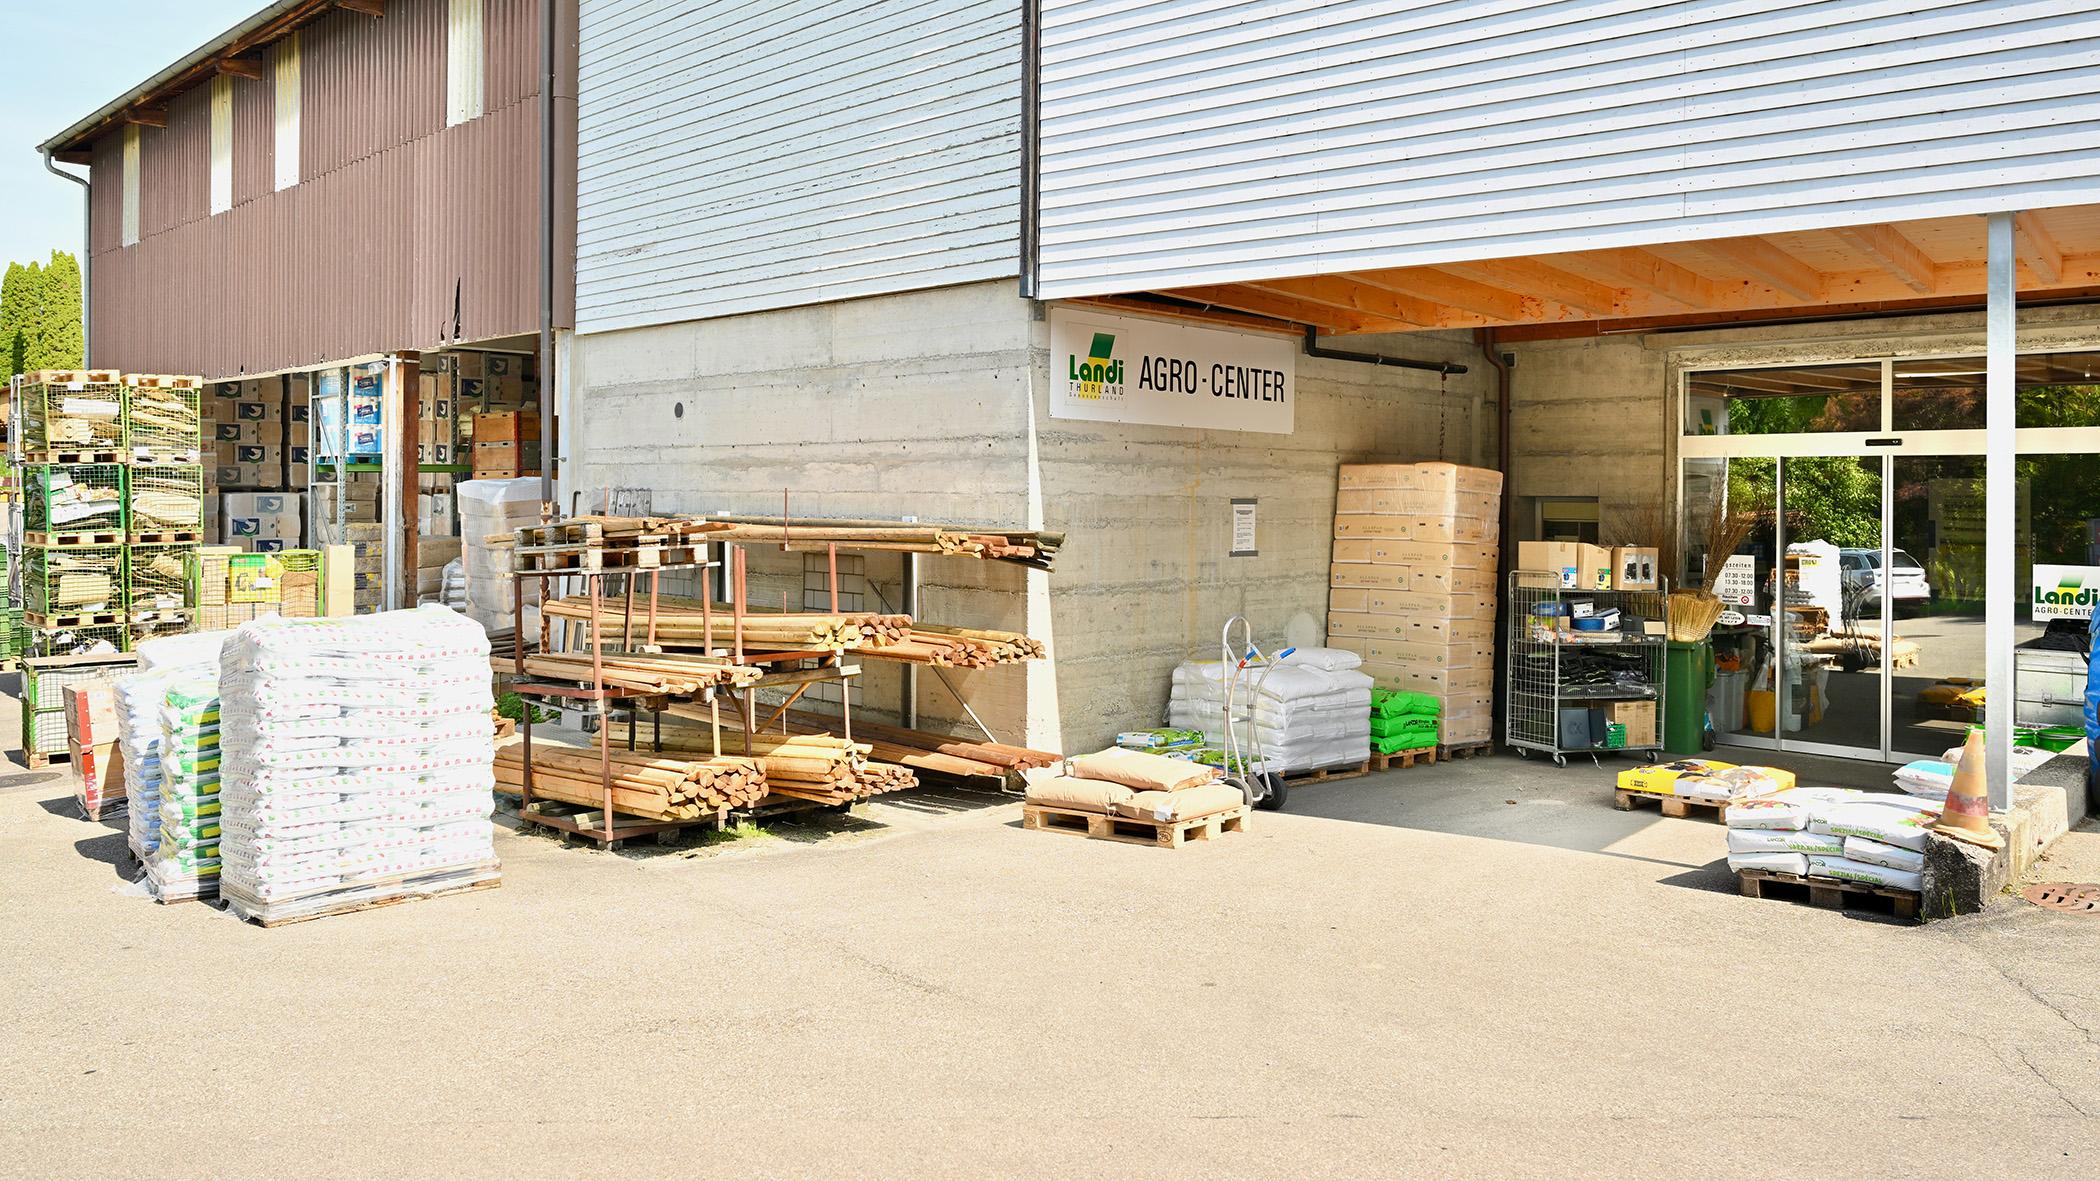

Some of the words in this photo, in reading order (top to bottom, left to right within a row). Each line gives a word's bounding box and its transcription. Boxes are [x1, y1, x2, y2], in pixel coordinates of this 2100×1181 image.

[1069, 354, 1124, 385] Landi
[1069, 382, 1124, 396] THURLAND
[2035, 586, 2099, 606] Landi
[2035, 606, 2092, 616] AGRO-CENTE
